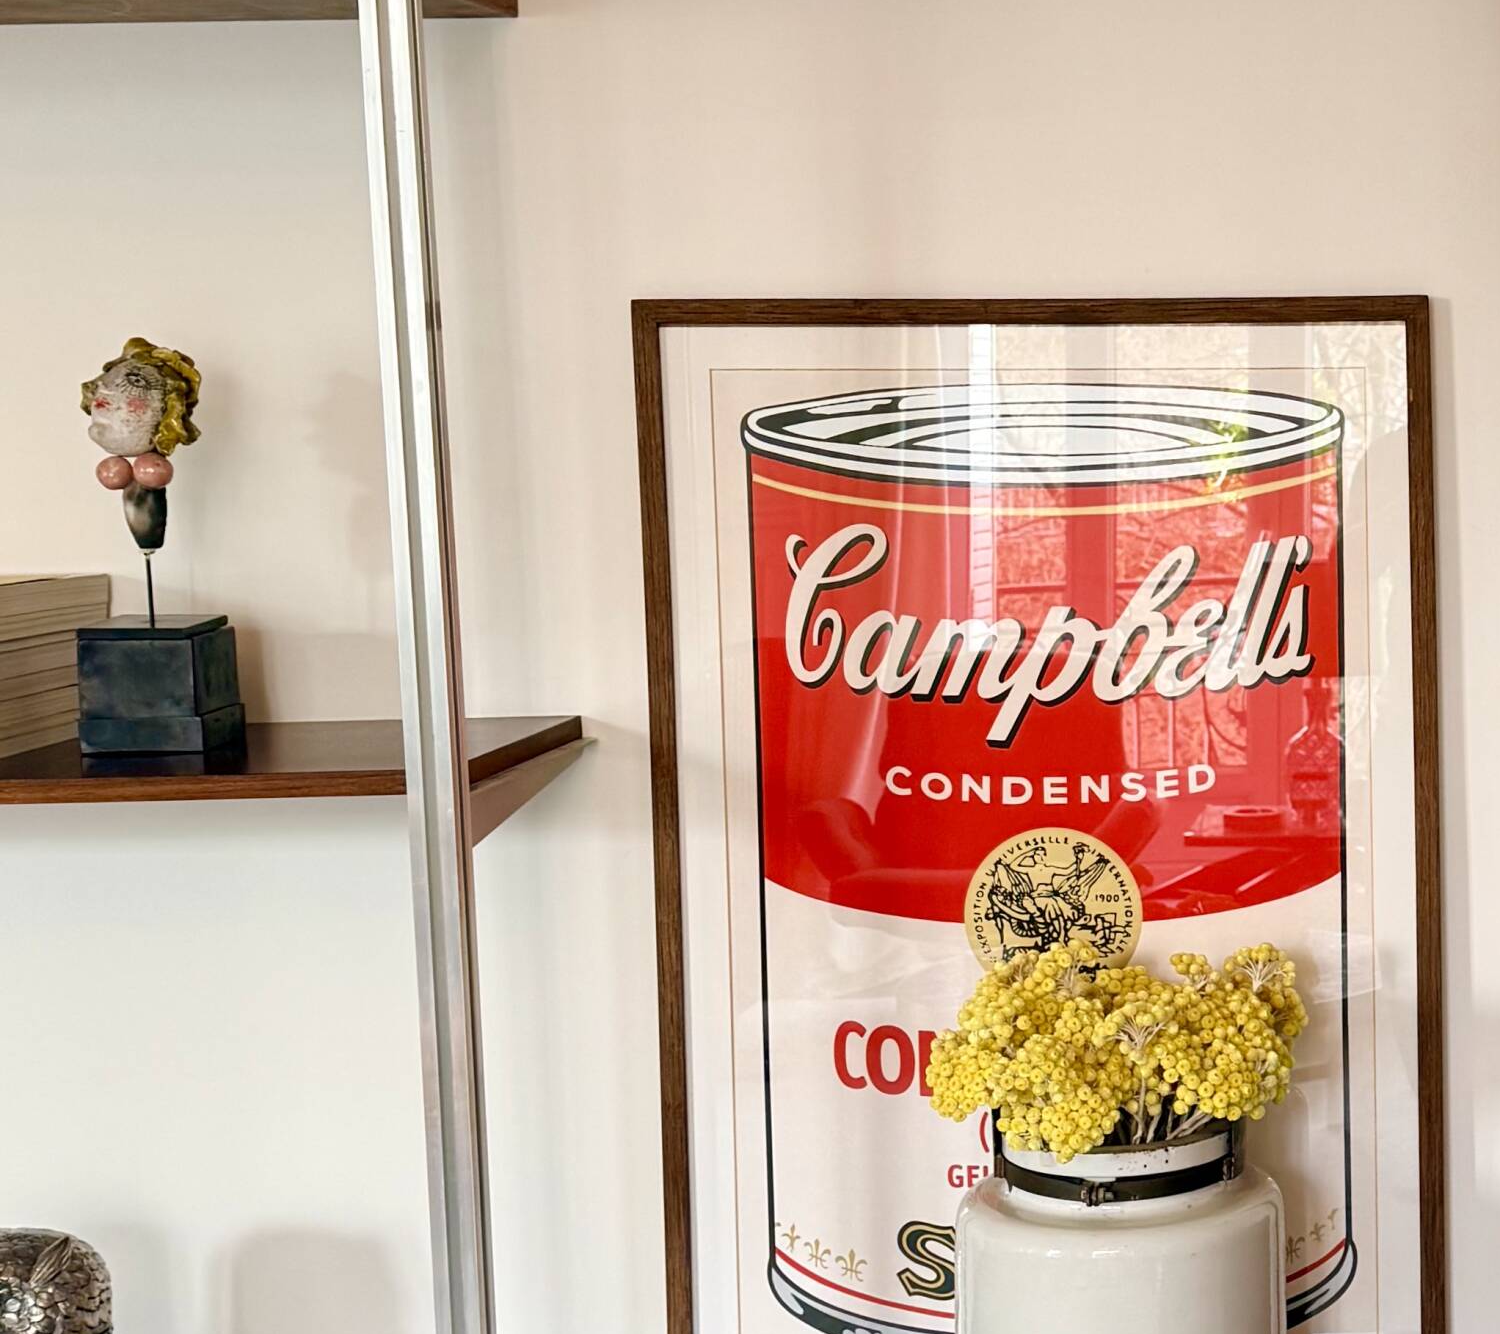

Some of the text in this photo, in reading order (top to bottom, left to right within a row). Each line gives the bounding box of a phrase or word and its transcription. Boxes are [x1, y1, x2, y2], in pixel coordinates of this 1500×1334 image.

[785, 523, 1315, 748] Campbell's
[885, 763, 1217, 805] CONDENSED
[973, 836, 1133, 955] EXPOSITION UIVERSELLE IERNATIONALE
[1095, 893, 1120, 903] 1900
